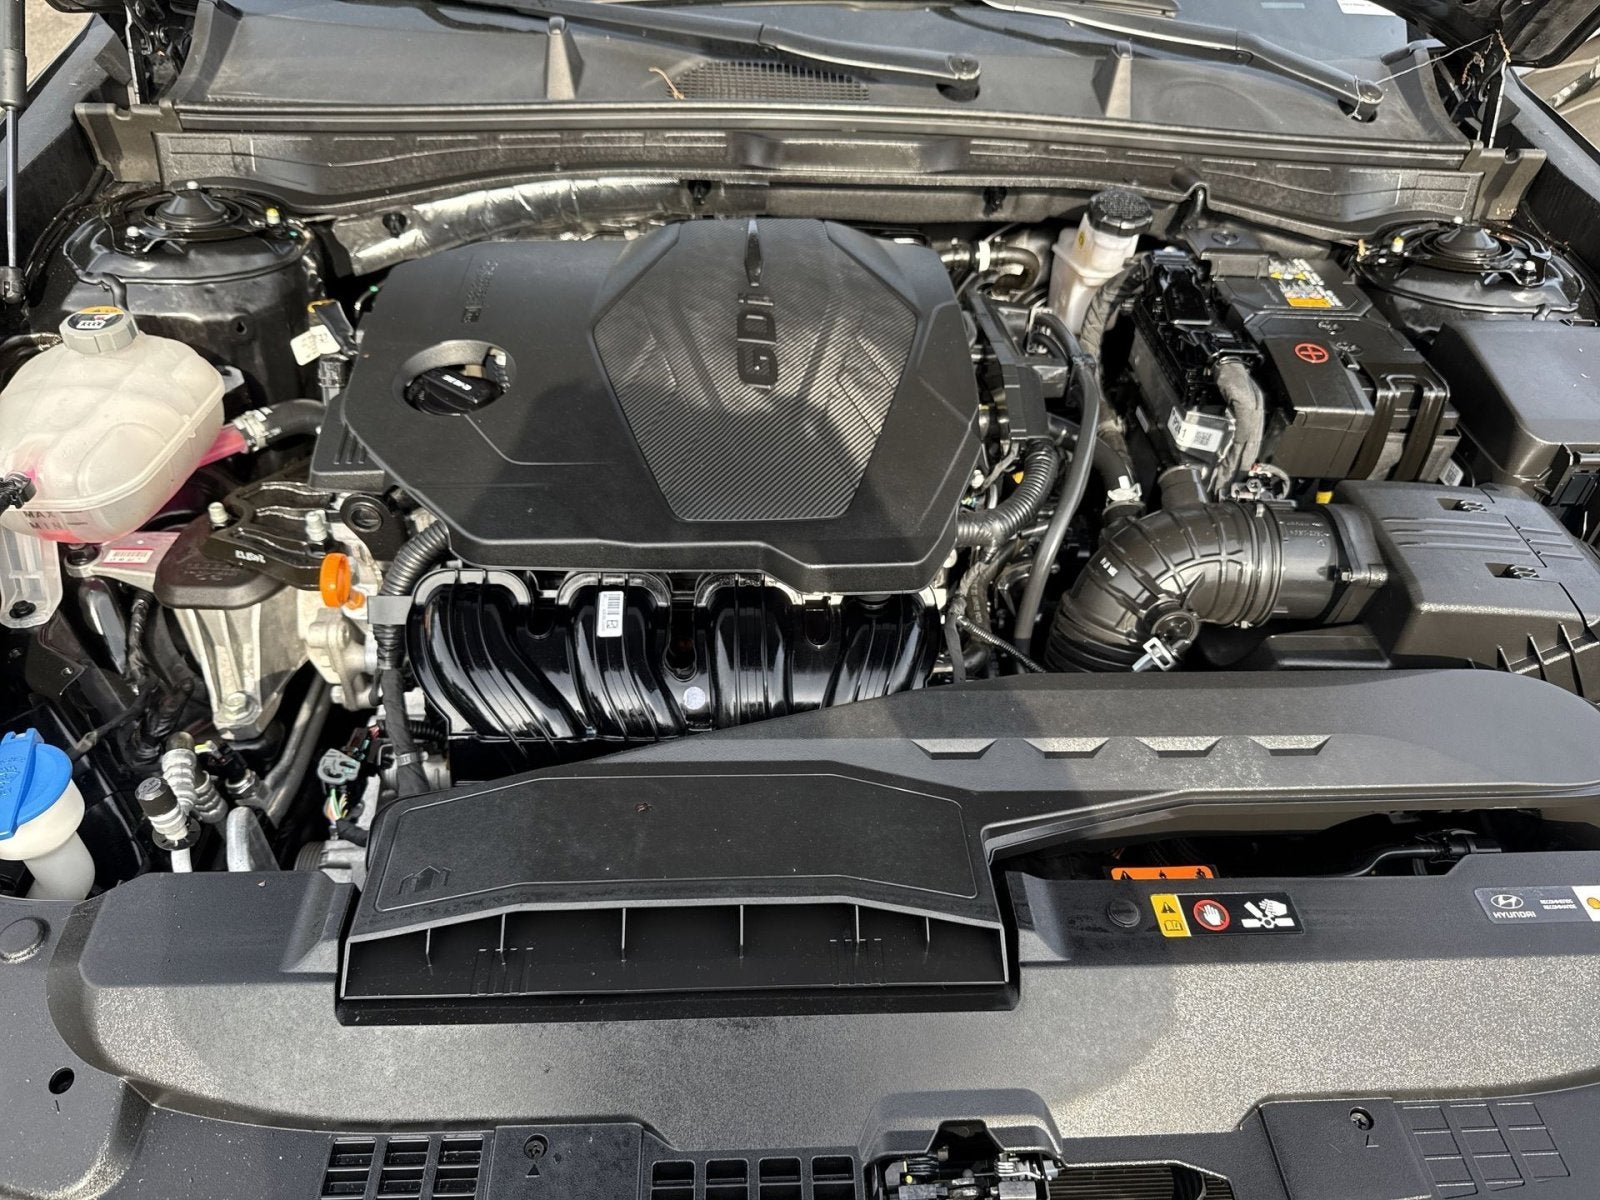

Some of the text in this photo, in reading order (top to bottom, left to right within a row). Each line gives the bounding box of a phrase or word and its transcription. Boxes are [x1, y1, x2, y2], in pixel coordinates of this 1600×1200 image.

[23, 510, 55, 519] MAX
[29, 521, 62, 530] MIN
[1493, 911, 1537, 919] HYUNDAI
